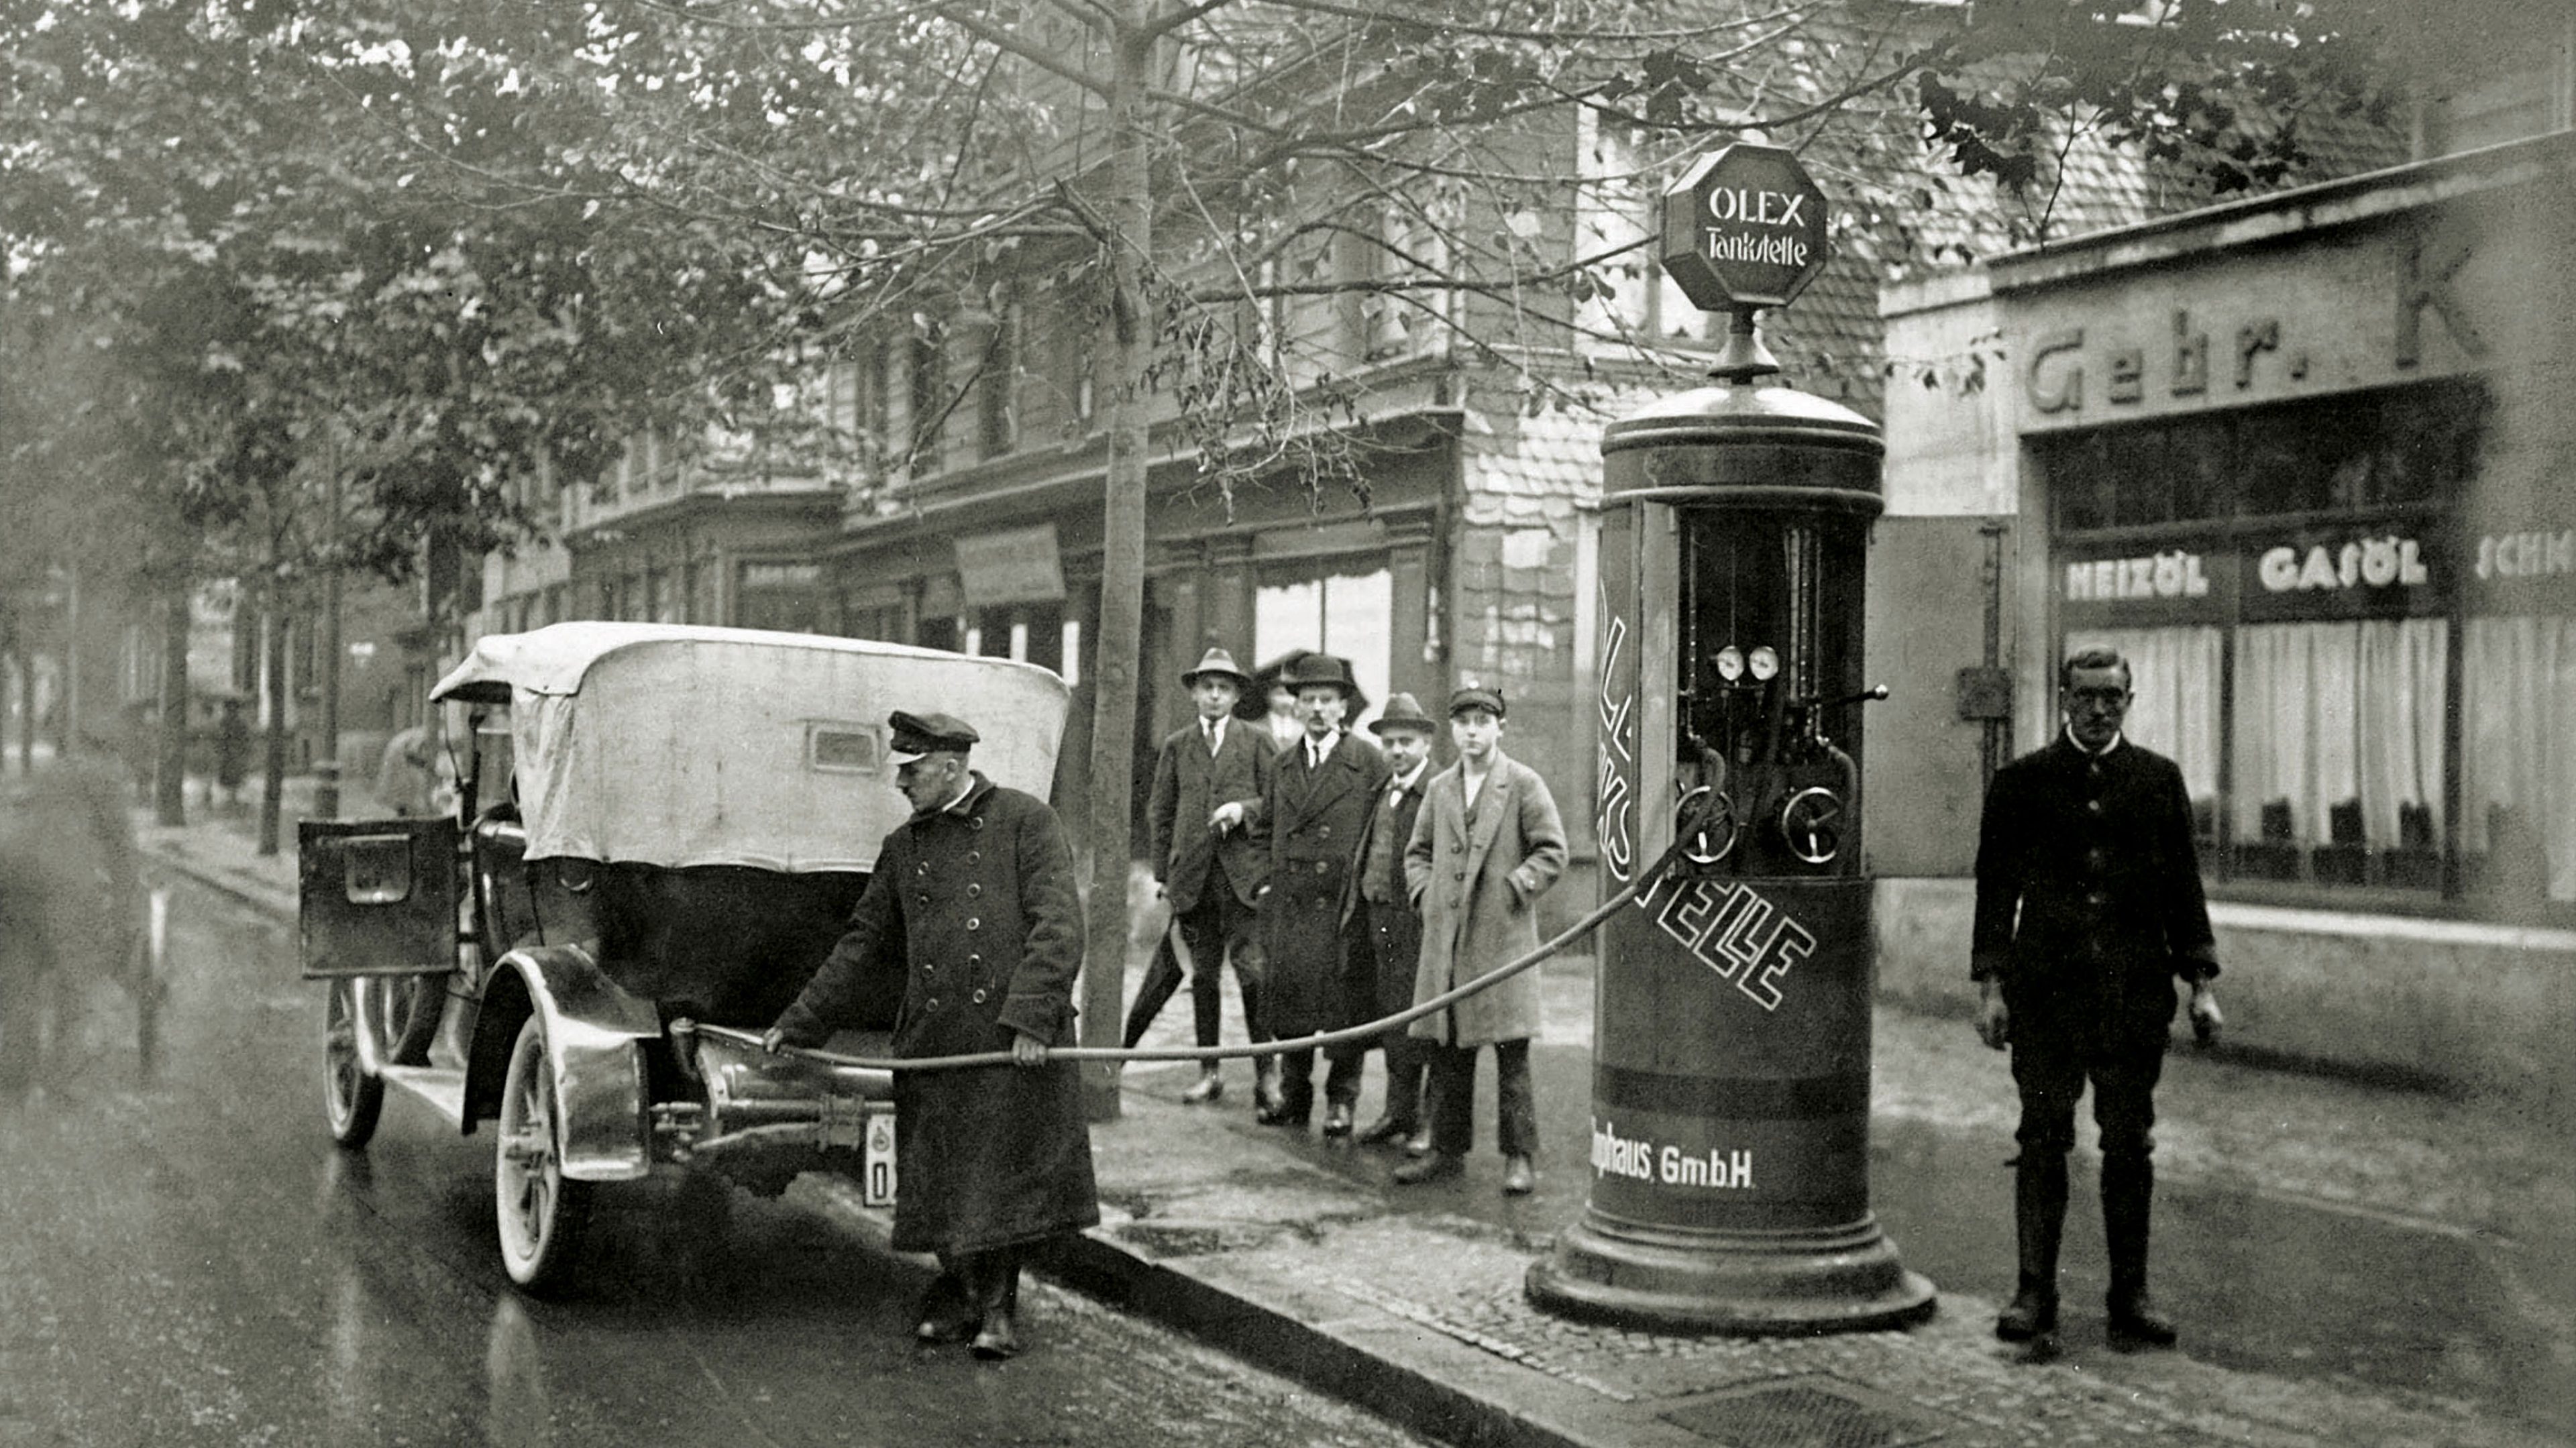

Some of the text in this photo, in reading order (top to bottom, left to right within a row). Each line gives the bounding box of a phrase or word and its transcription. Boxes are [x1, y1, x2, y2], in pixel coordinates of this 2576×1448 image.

[1709, 186, 1805, 227] OLEX
[1706, 226, 1808, 266] Tankstelle
[2025, 310, 2309, 414] Gebr.
[2067, 550, 2209, 600] HEIZÖL
[2259, 535, 2428, 592] GASÖL
